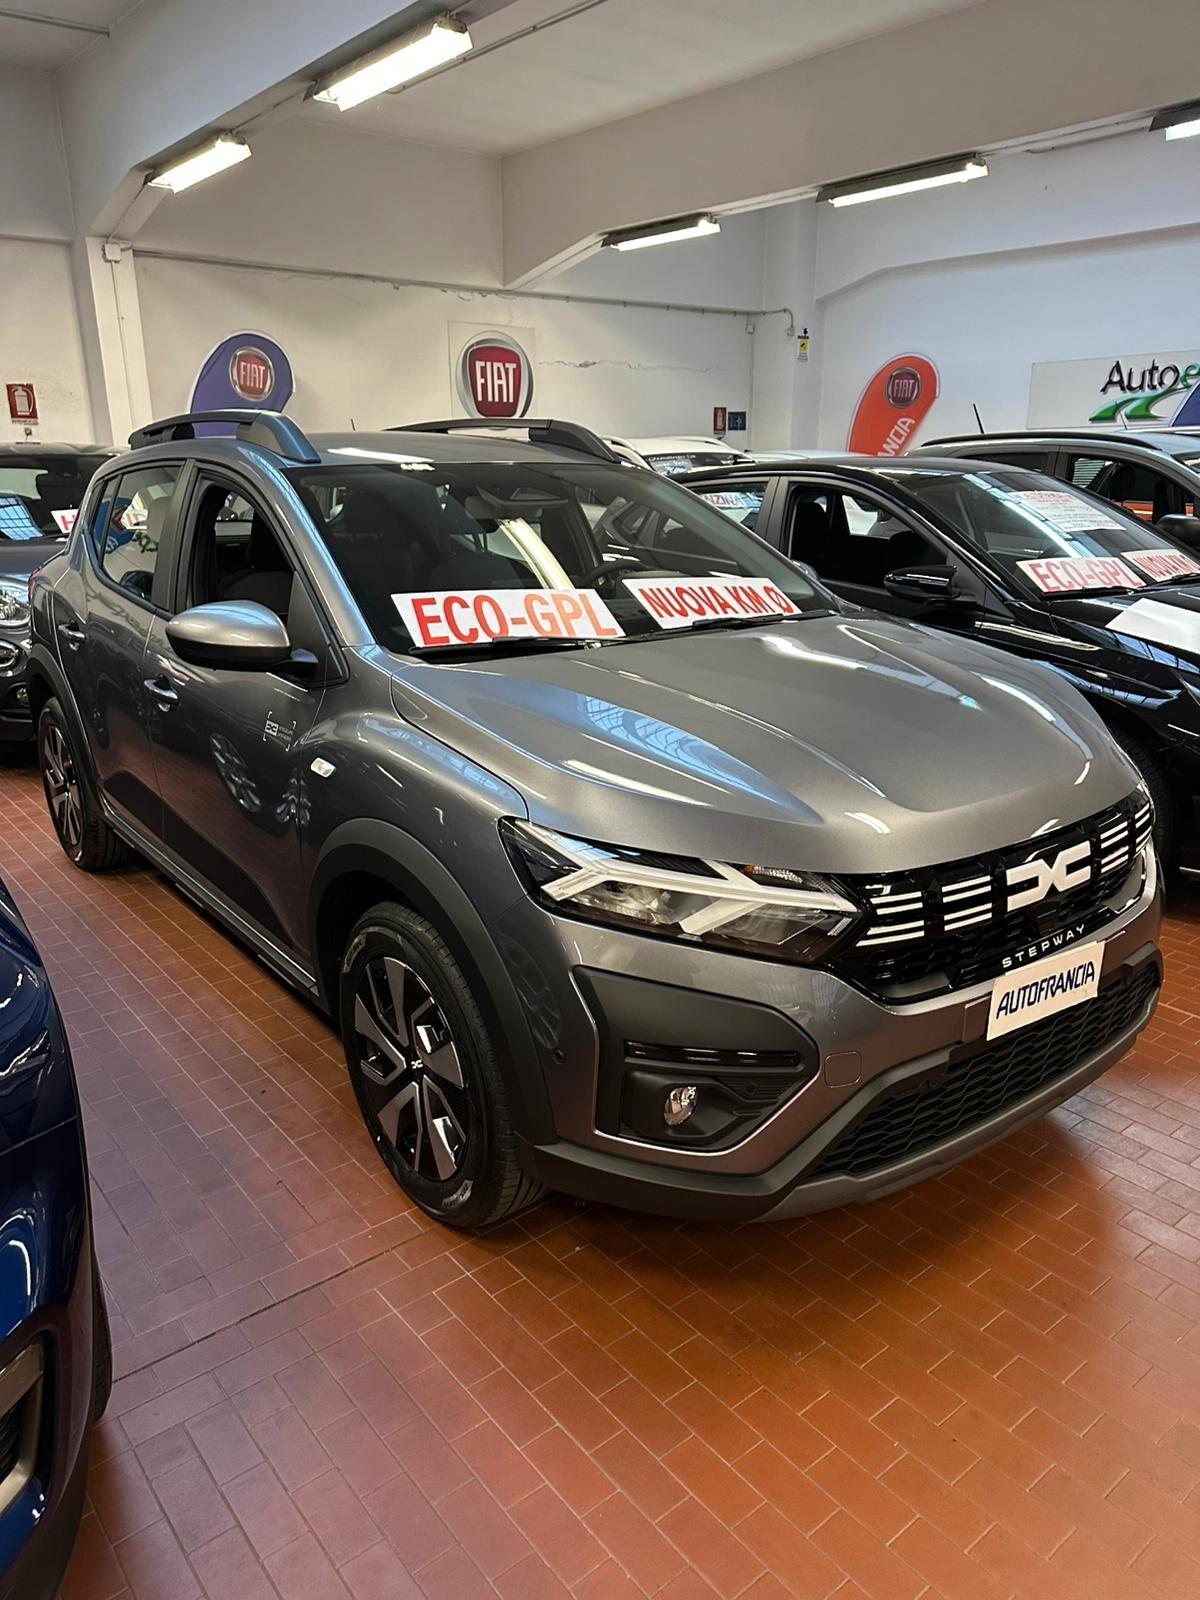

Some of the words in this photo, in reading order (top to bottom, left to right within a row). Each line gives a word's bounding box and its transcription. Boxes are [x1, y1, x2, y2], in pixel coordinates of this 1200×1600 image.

[240, 362, 266, 389] FIAT
[475, 360, 517, 403] FIAT
[893, 379, 915, 398] FIAT
[1028, 559, 1142, 592] ECO-GPL
[412, 593, 617, 646] ECO-GPL
[639, 586, 739, 618] NUOVA
[724, 586, 776, 613] KM
[1002, 924, 1085, 968] STEPWAY
[996, 961, 1095, 1020] AUTOFRANCIA
